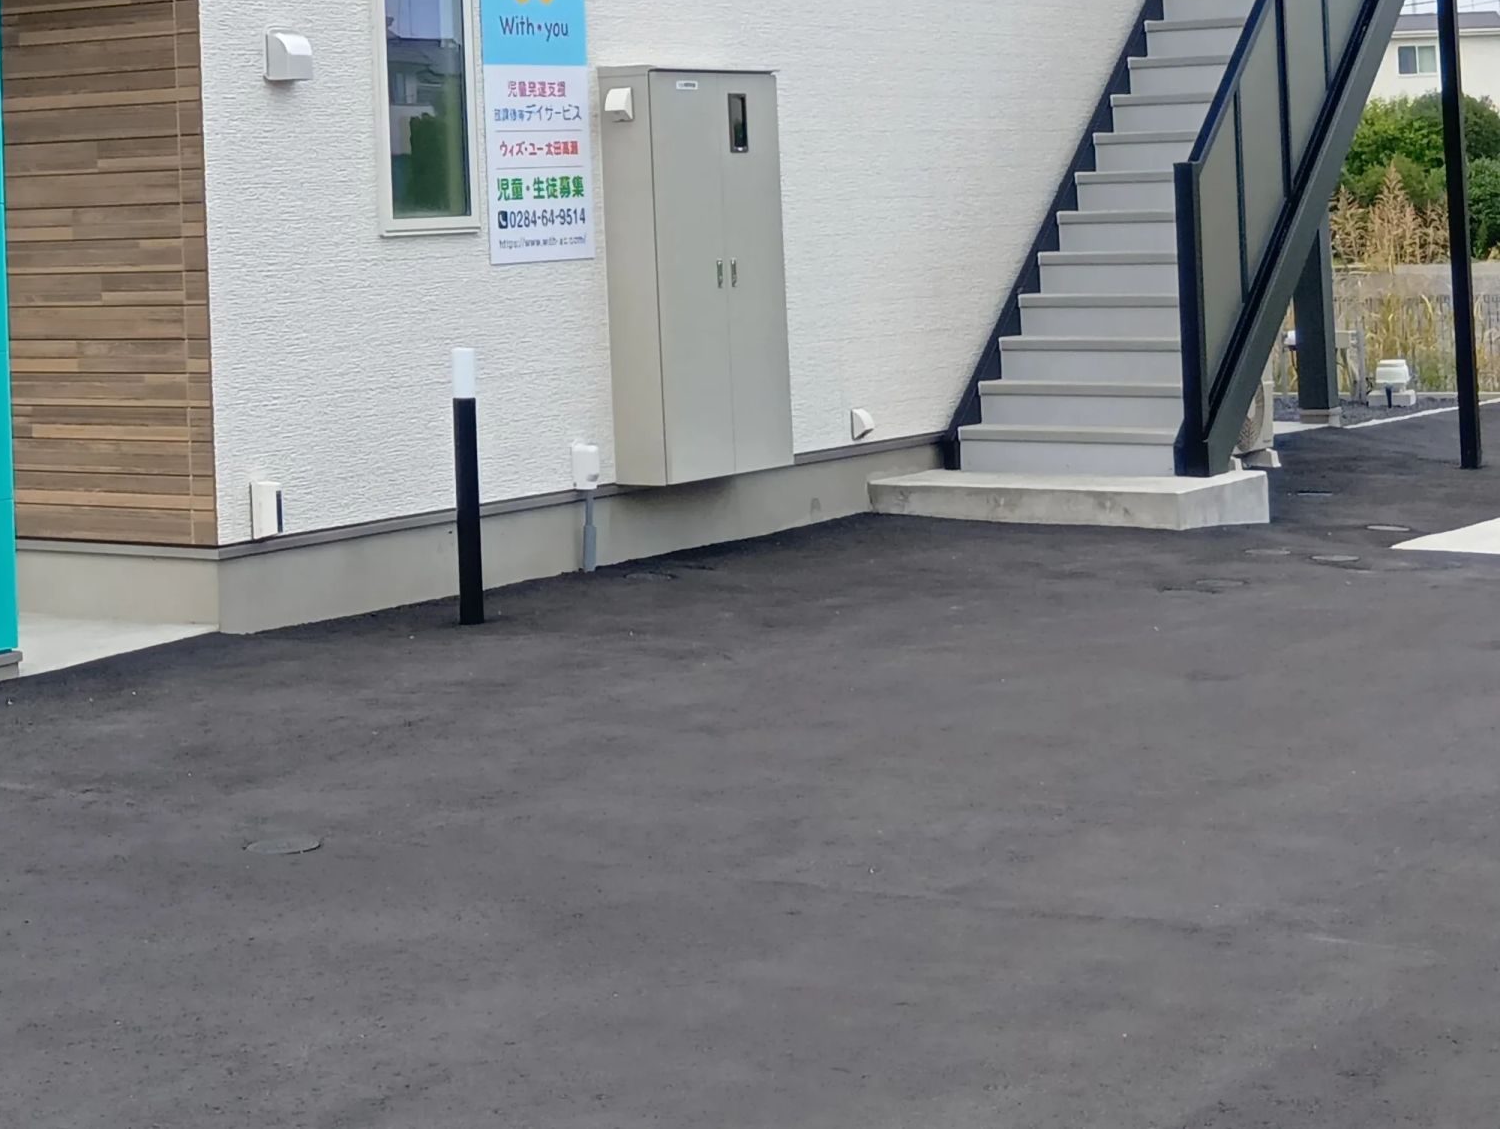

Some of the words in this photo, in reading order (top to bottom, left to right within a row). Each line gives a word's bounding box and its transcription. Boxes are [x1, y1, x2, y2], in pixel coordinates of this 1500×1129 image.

[497, 175, 584, 201] 児童・生徒募集
[509, 208, 586, 228] 0284-64-9514
